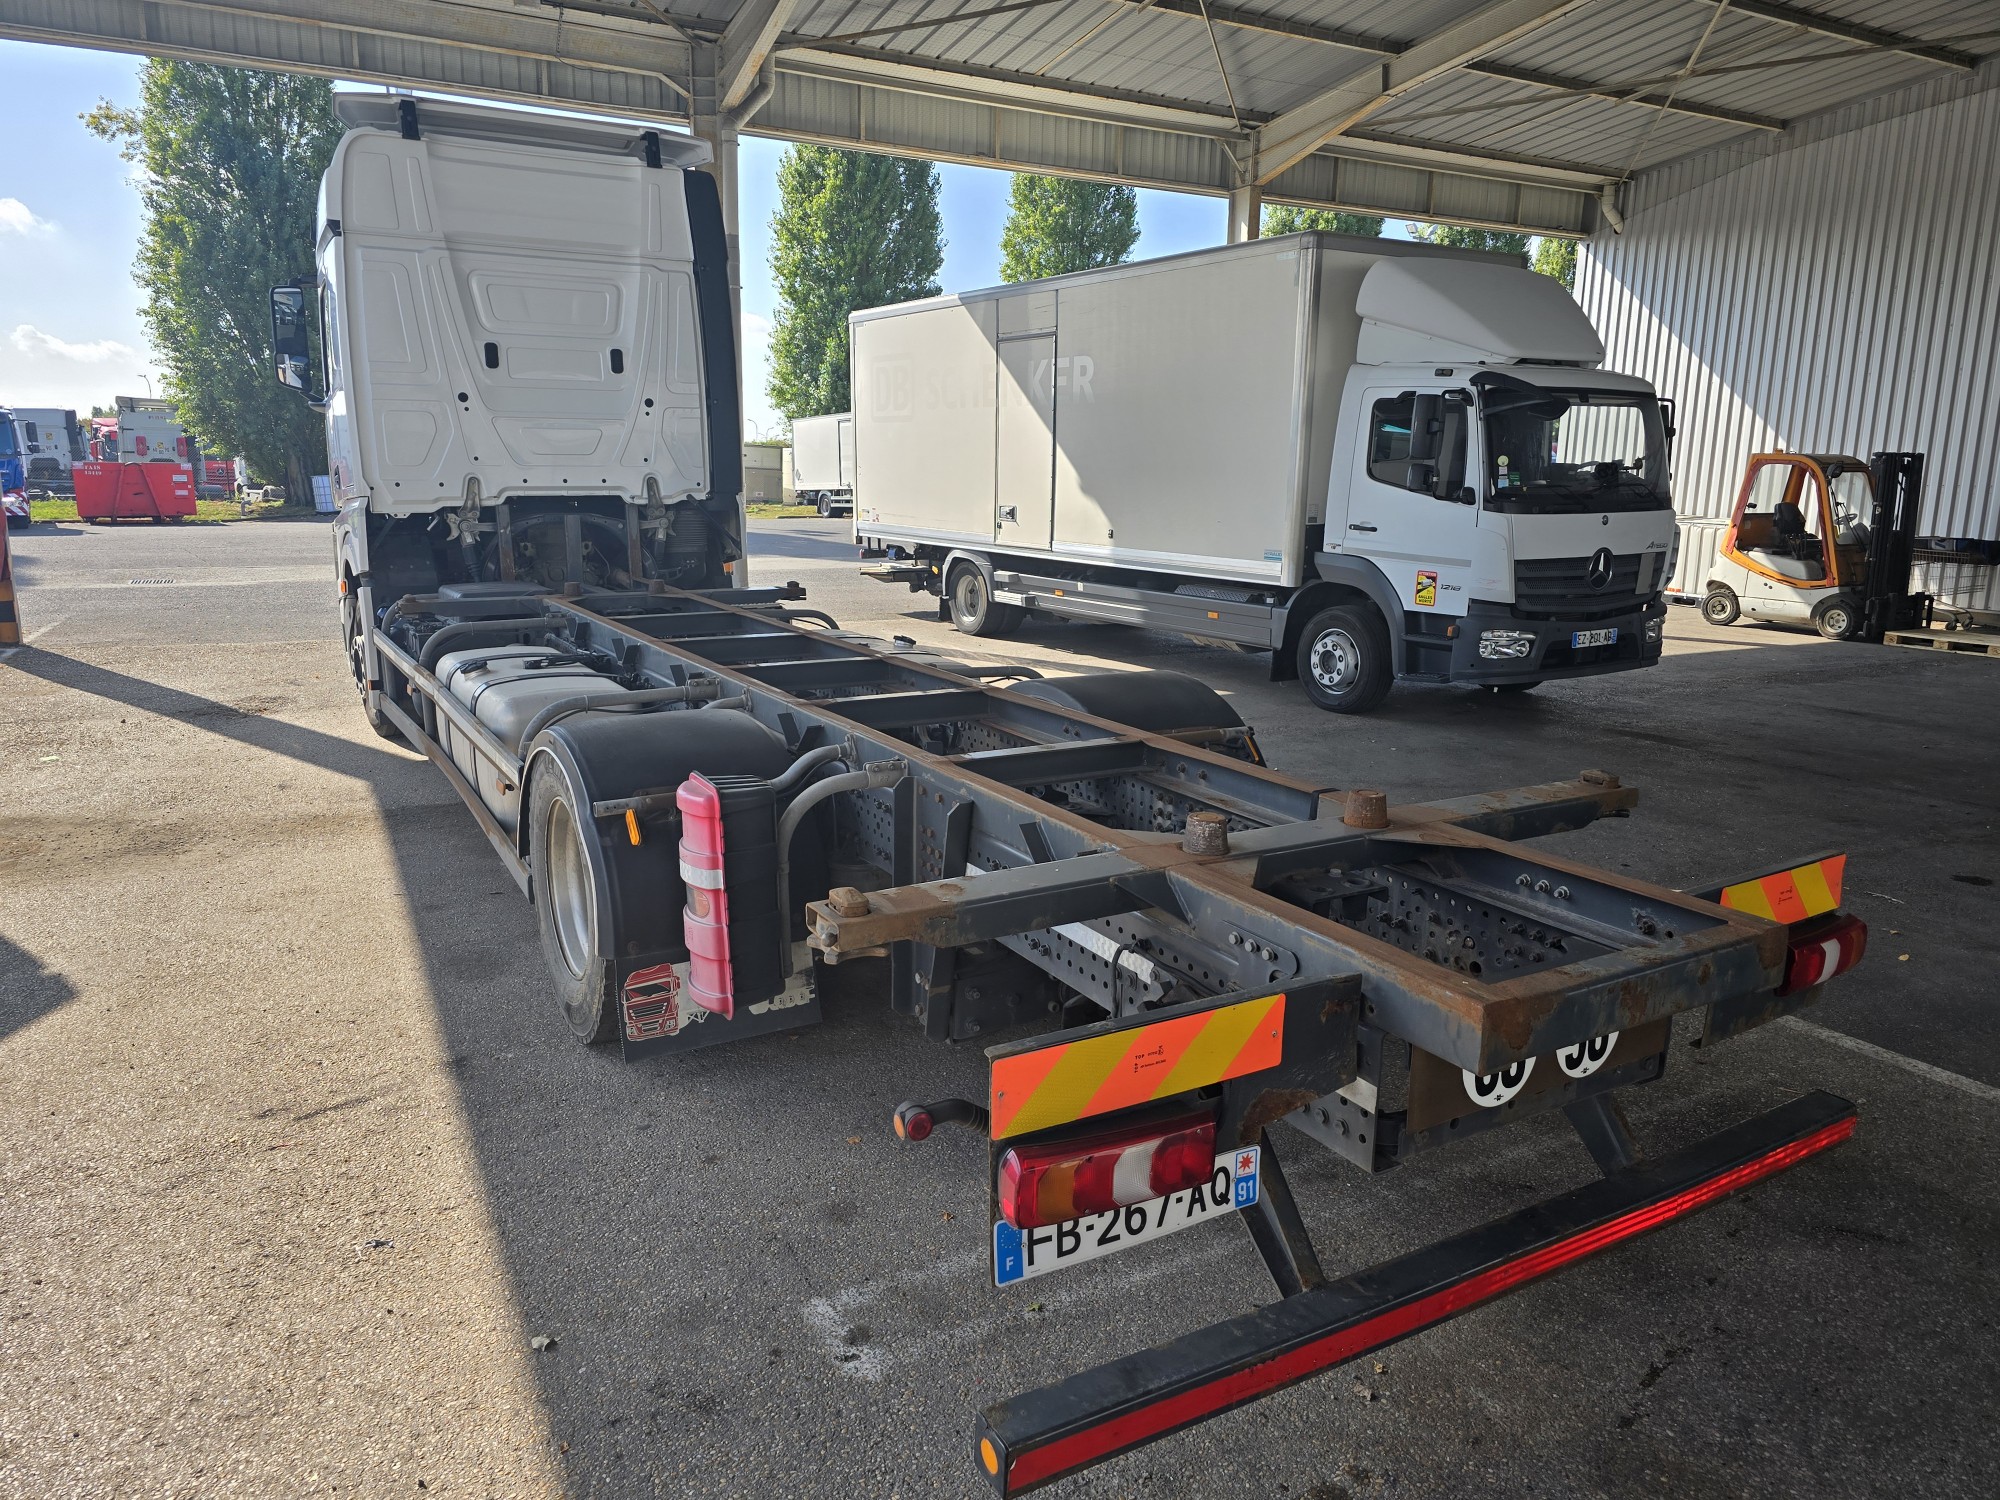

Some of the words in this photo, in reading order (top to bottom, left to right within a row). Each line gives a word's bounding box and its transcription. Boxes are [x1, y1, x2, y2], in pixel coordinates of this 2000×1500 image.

[1440, 584, 1462, 592] 1218
[1237, 1180, 1254, 1202] 91
[1005, 1256, 1015, 1272] F
